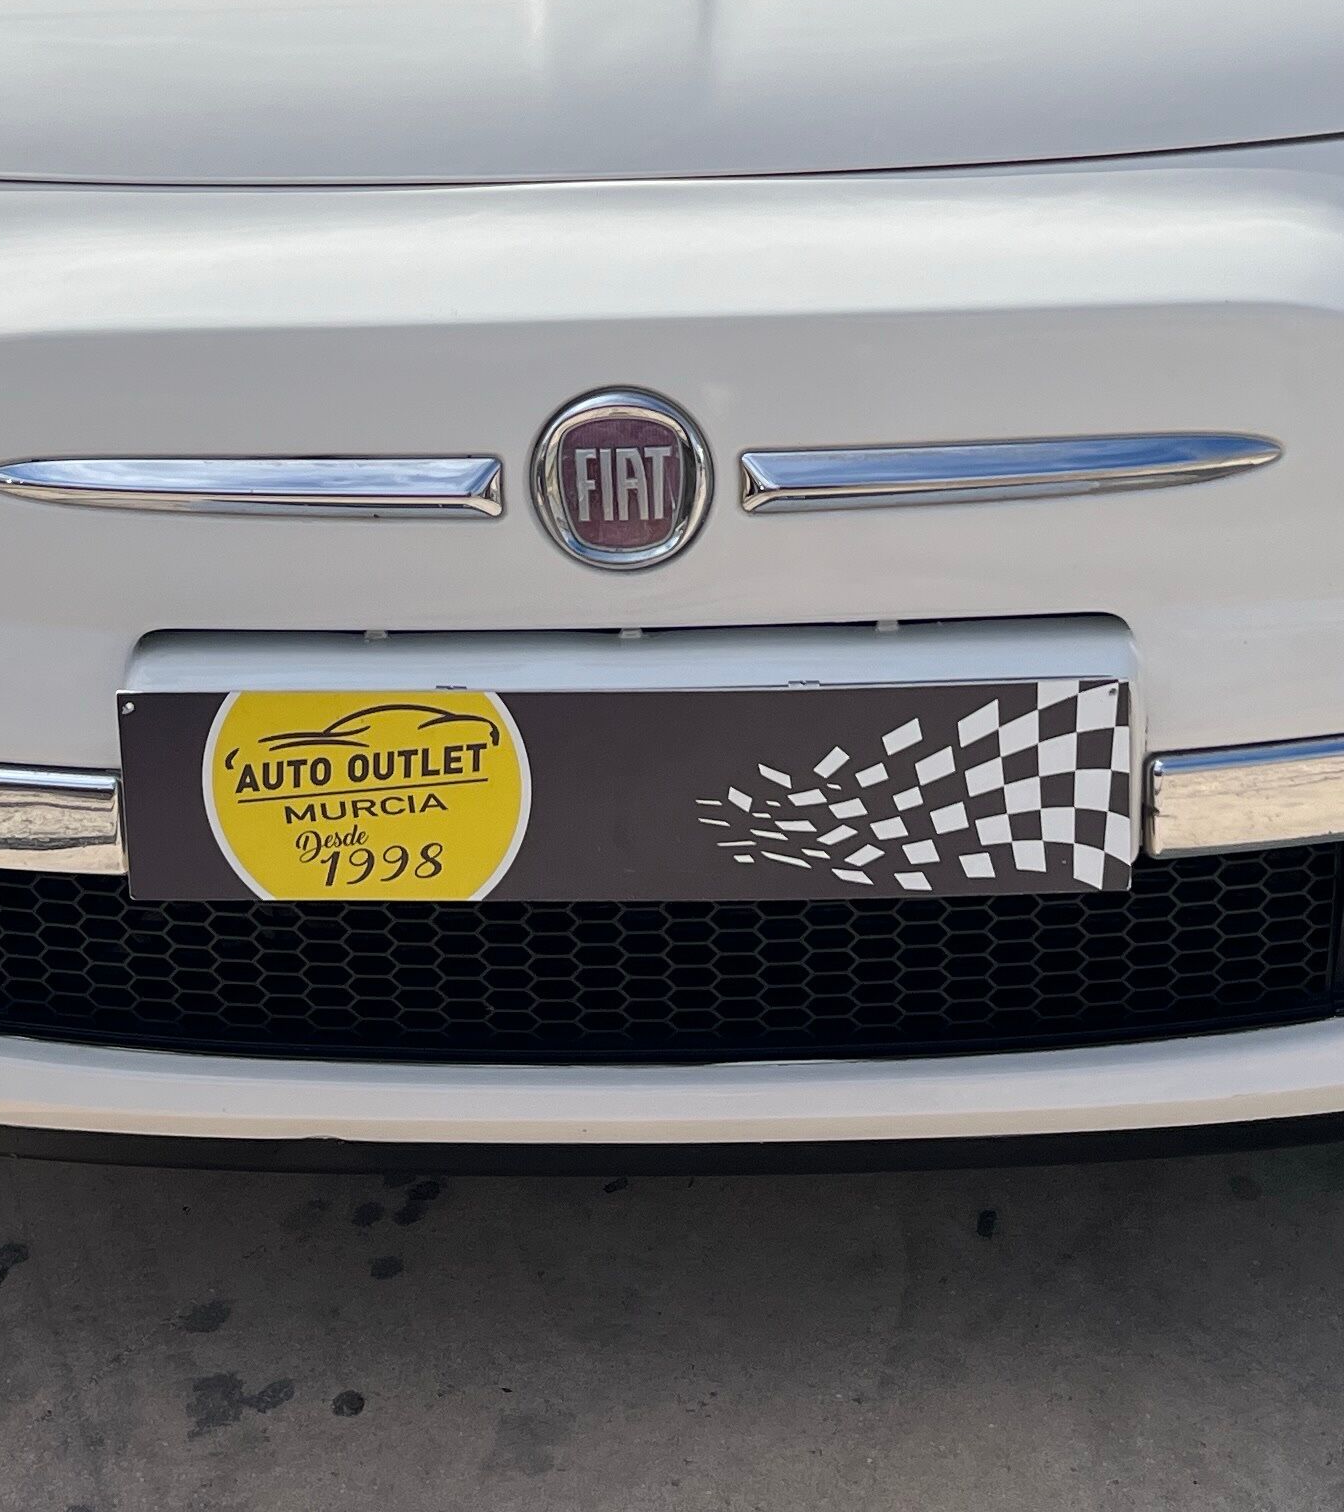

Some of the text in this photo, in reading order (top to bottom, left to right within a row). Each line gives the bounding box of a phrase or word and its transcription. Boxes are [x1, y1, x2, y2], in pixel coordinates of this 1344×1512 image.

[574, 445, 673, 521] FIAT
[235, 742, 488, 793] AUTO OUTLET
[284, 793, 448, 824] MURCIA
[296, 824, 369, 863] Desde
[320, 842, 444, 886] 1998
